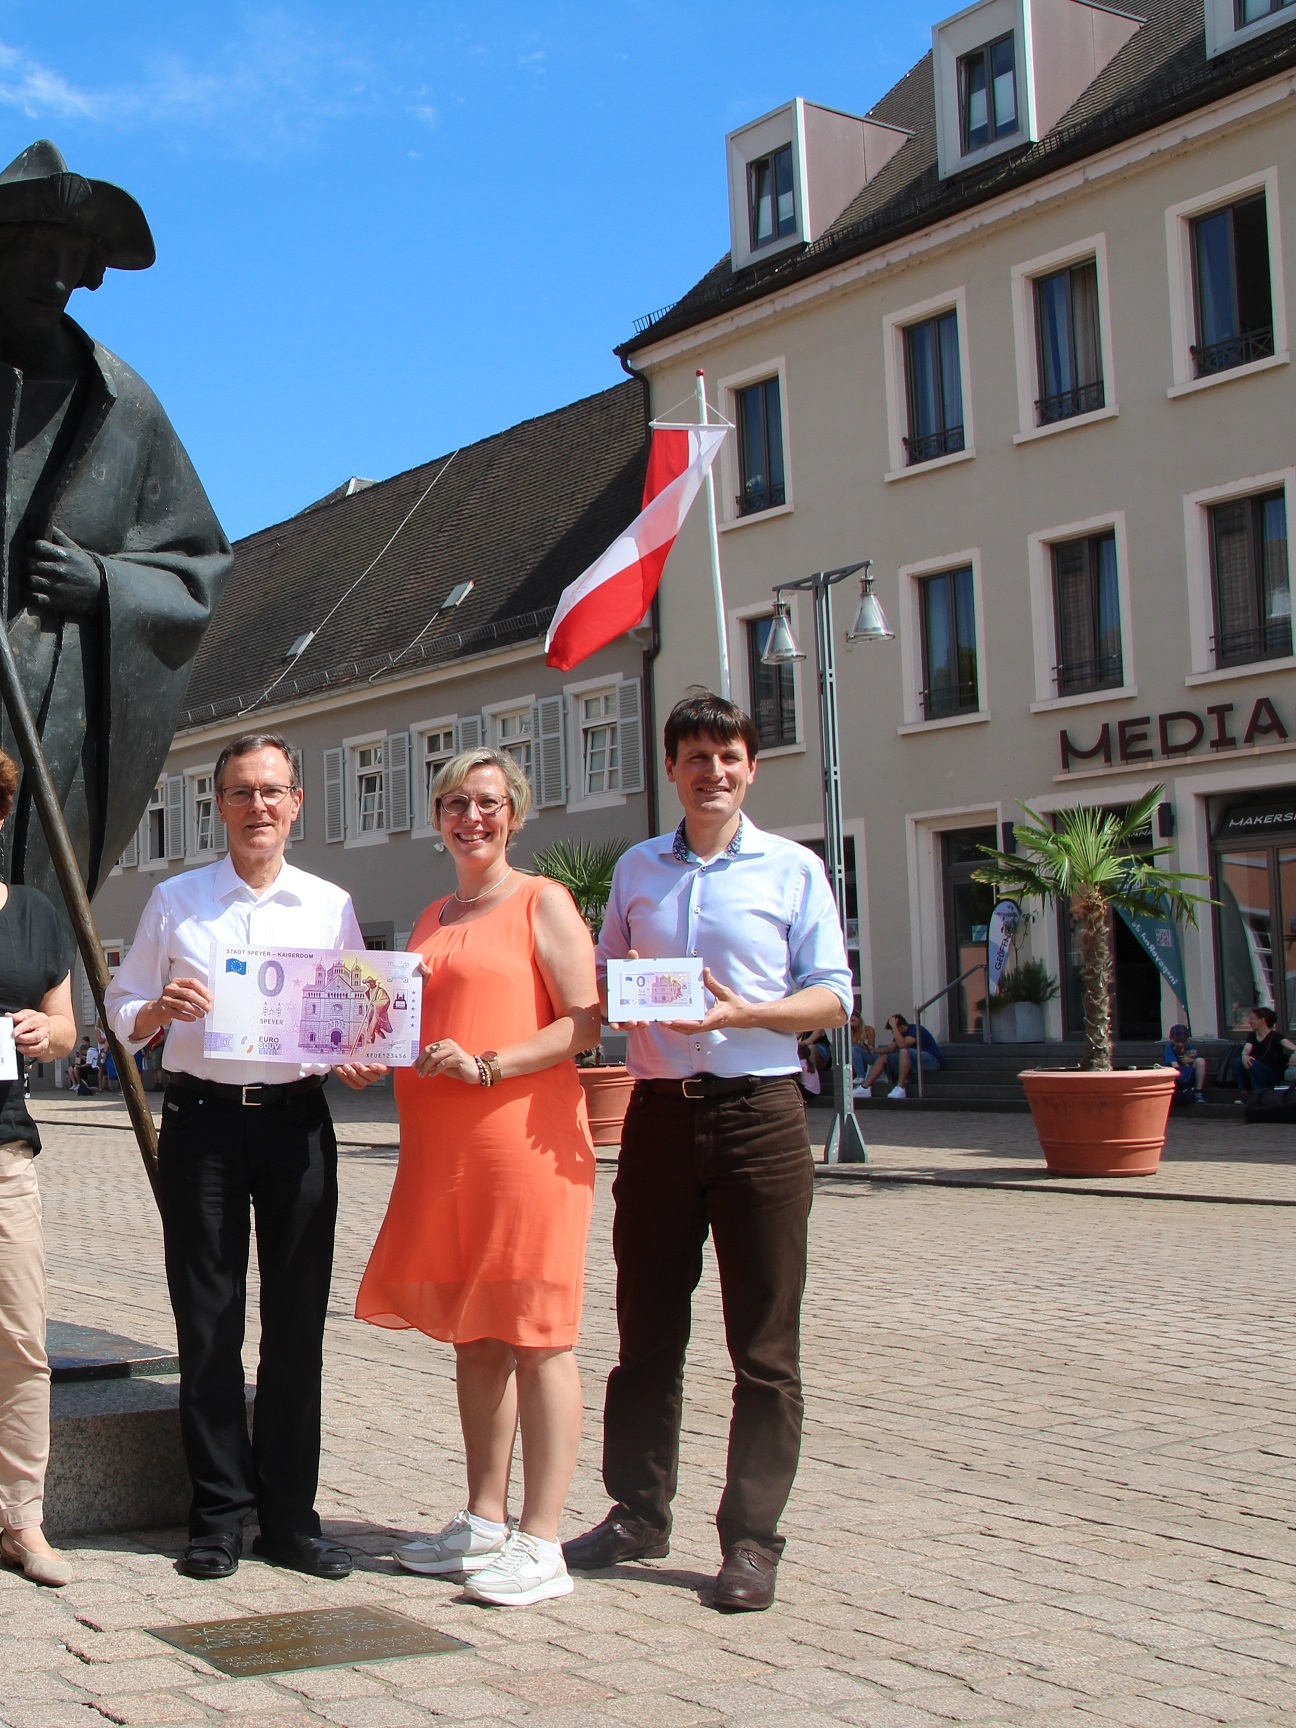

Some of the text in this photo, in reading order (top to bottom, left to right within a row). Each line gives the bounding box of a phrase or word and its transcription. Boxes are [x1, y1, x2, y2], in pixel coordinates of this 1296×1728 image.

[1059, 697, 1289, 769] MEDIA
[1228, 812, 1296, 828] MAKERS
[257, 960, 285, 997] 0
[259, 1018, 284, 1026] SPEYER
